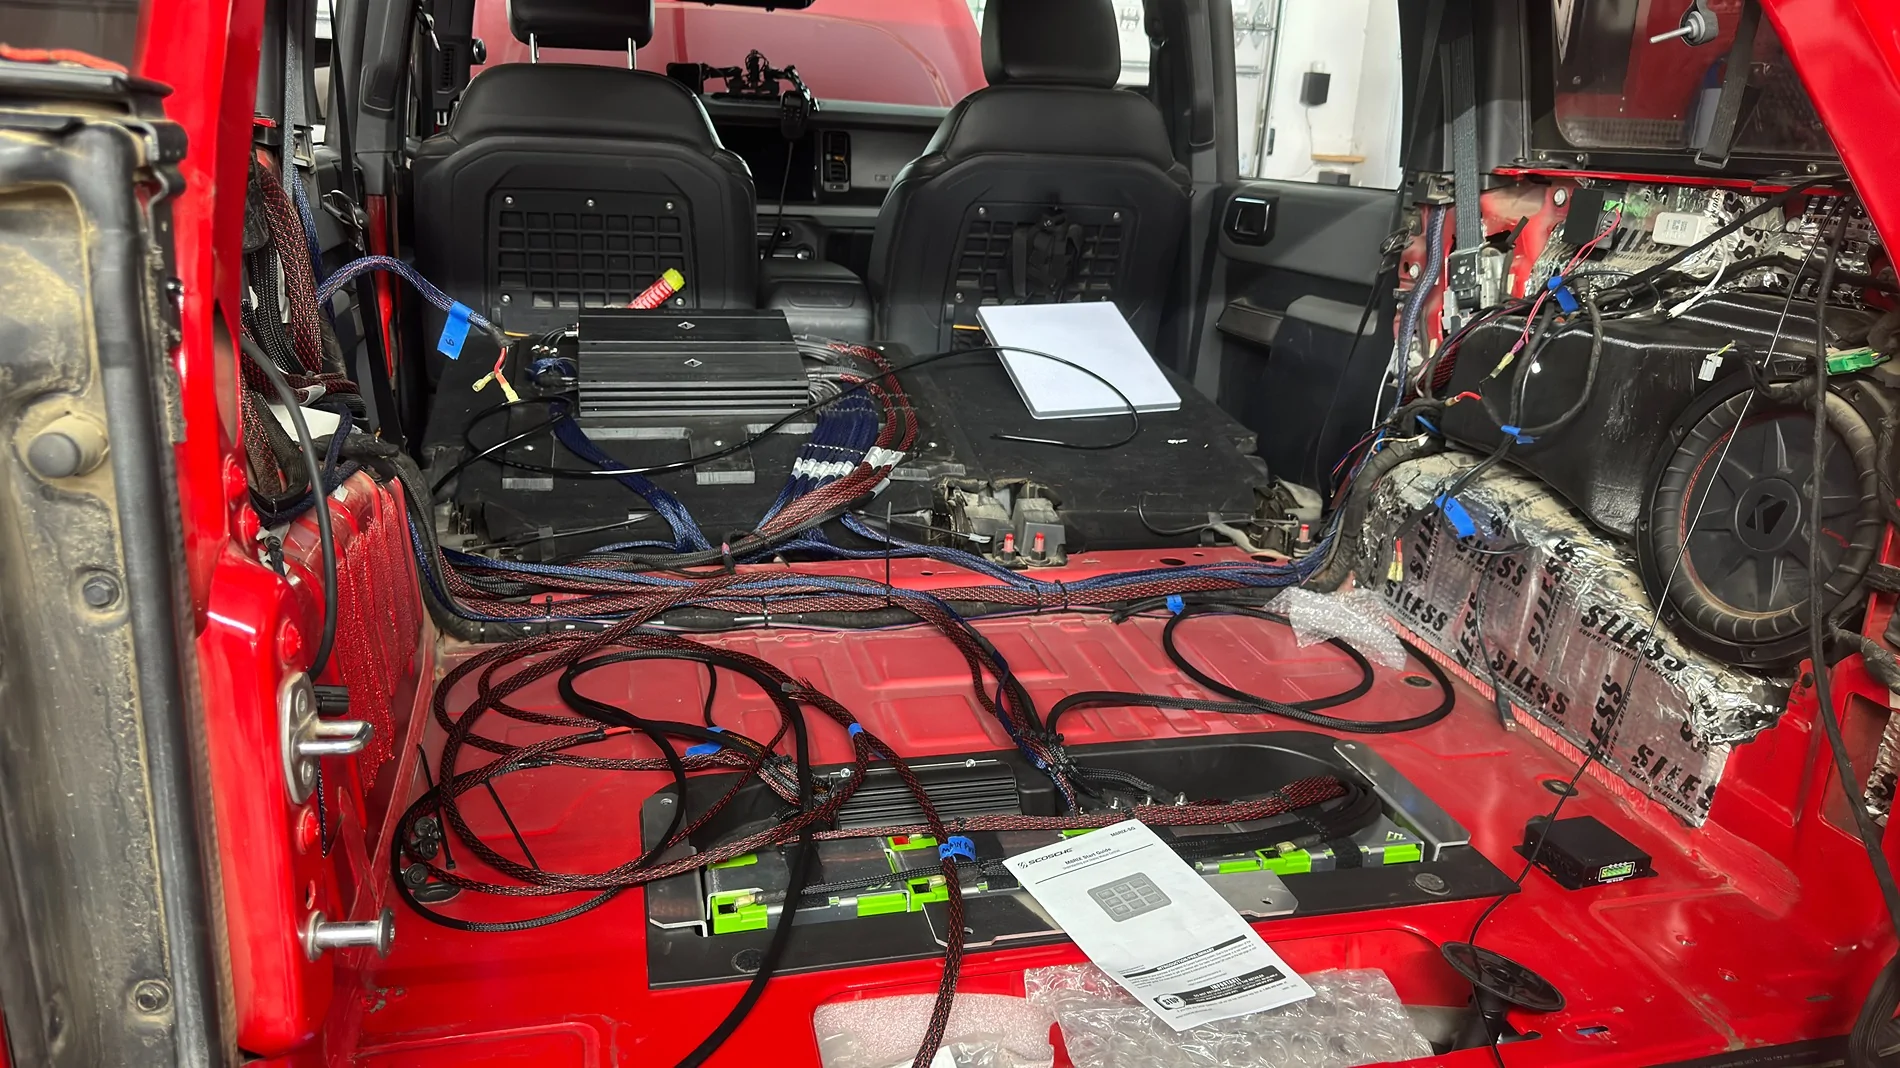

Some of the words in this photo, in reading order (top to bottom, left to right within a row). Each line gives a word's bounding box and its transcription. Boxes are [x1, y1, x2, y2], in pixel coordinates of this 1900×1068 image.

[1384, 580, 1448, 631] SILESS
[1491, 650, 1570, 715] SILESS
[1028, 848, 1074, 865] SCOSCHE
[1164, 996, 1180, 1006] STOP
